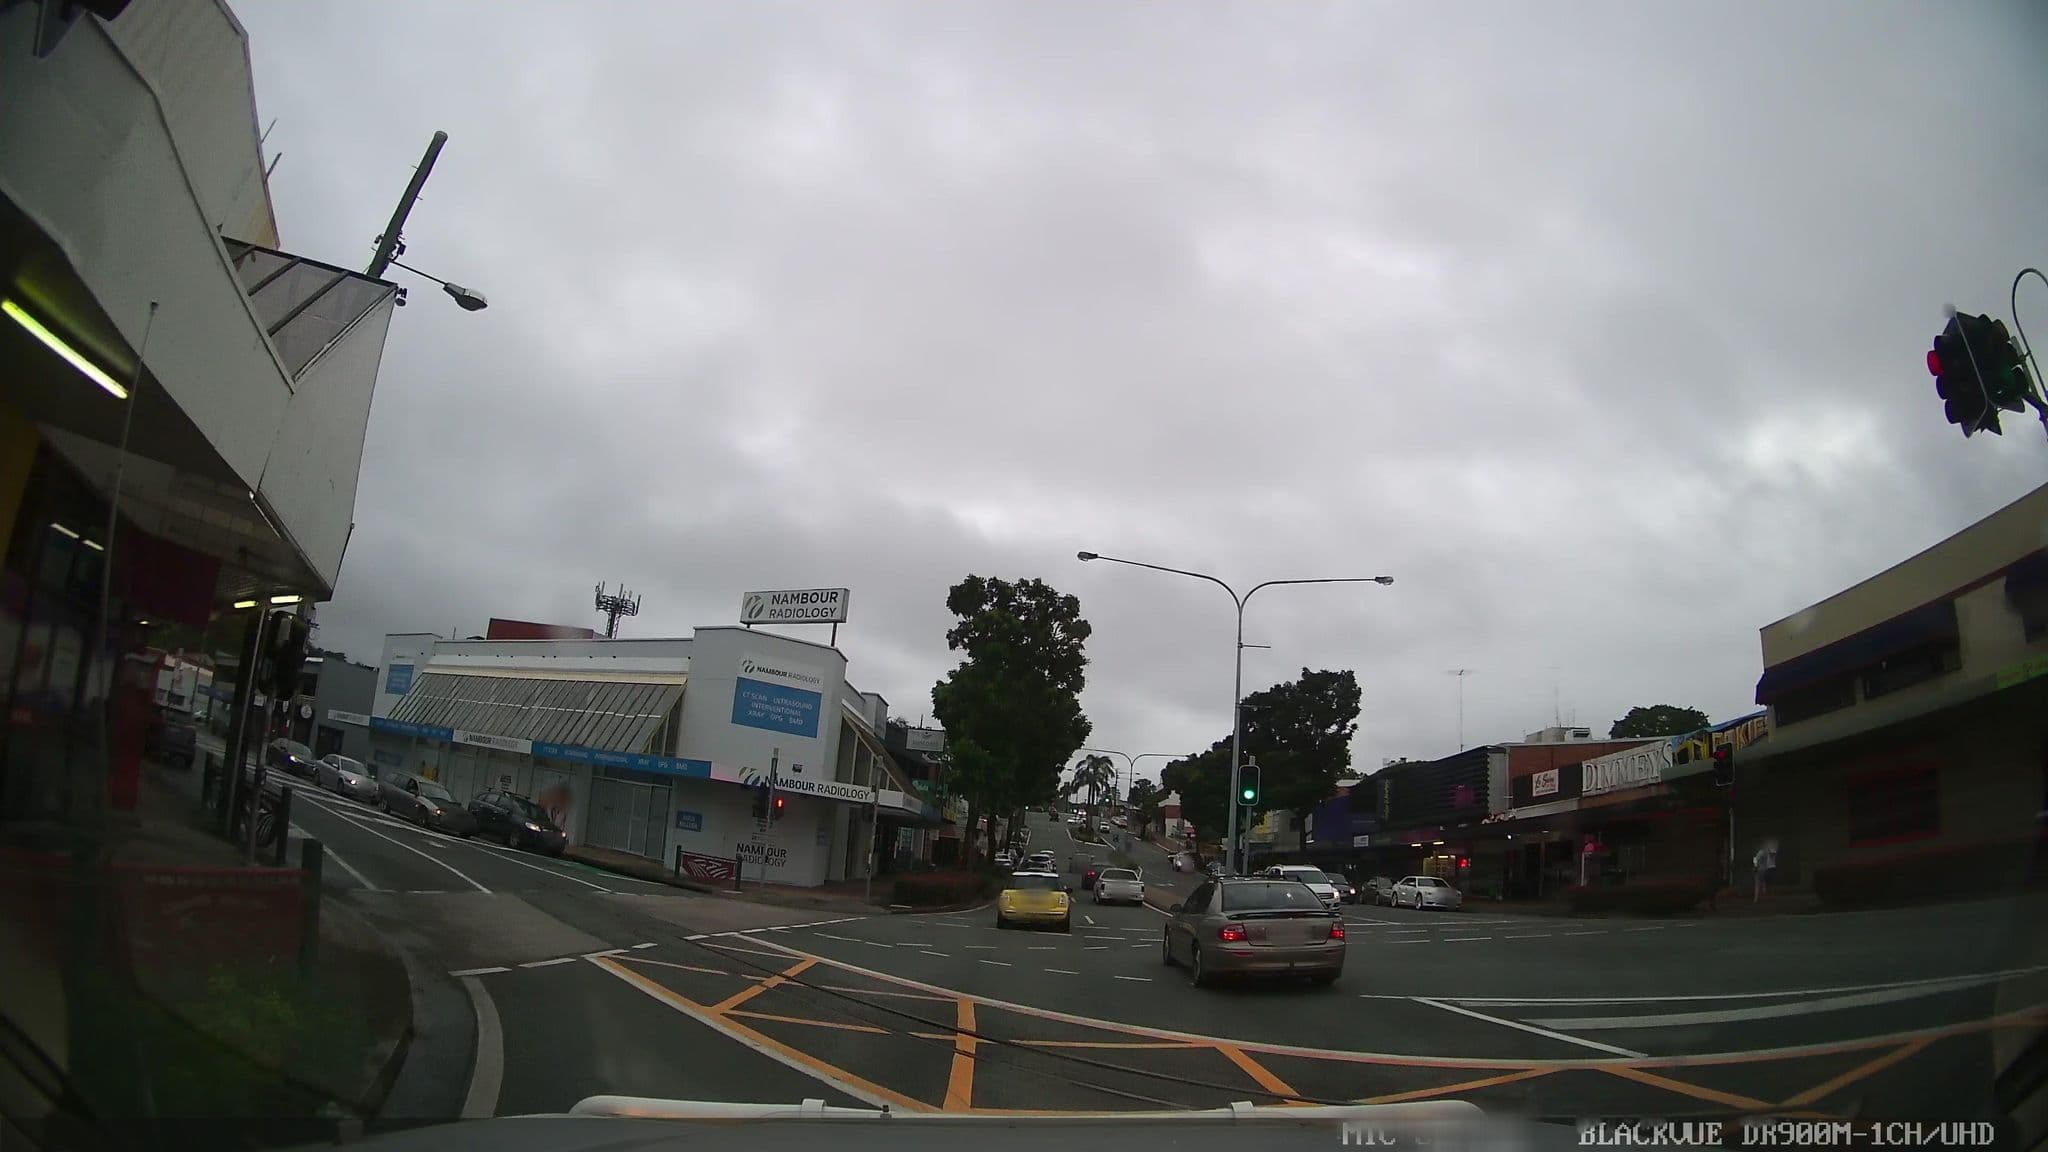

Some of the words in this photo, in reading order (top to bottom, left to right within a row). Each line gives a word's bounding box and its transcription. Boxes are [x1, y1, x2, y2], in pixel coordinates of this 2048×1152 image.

[772, 591, 839, 605] NAMBOUR
[768, 607, 837, 619] RADIOLOGY
[756, 665, 788, 677] NAMBOUR
[788, 671, 820, 684] RADIOLOGY
[1581, 741, 1673, 793] DIMMEYS
[764, 776, 815, 792] NAMBOUR
[817, 783, 870, 801] RADIOLOGY
